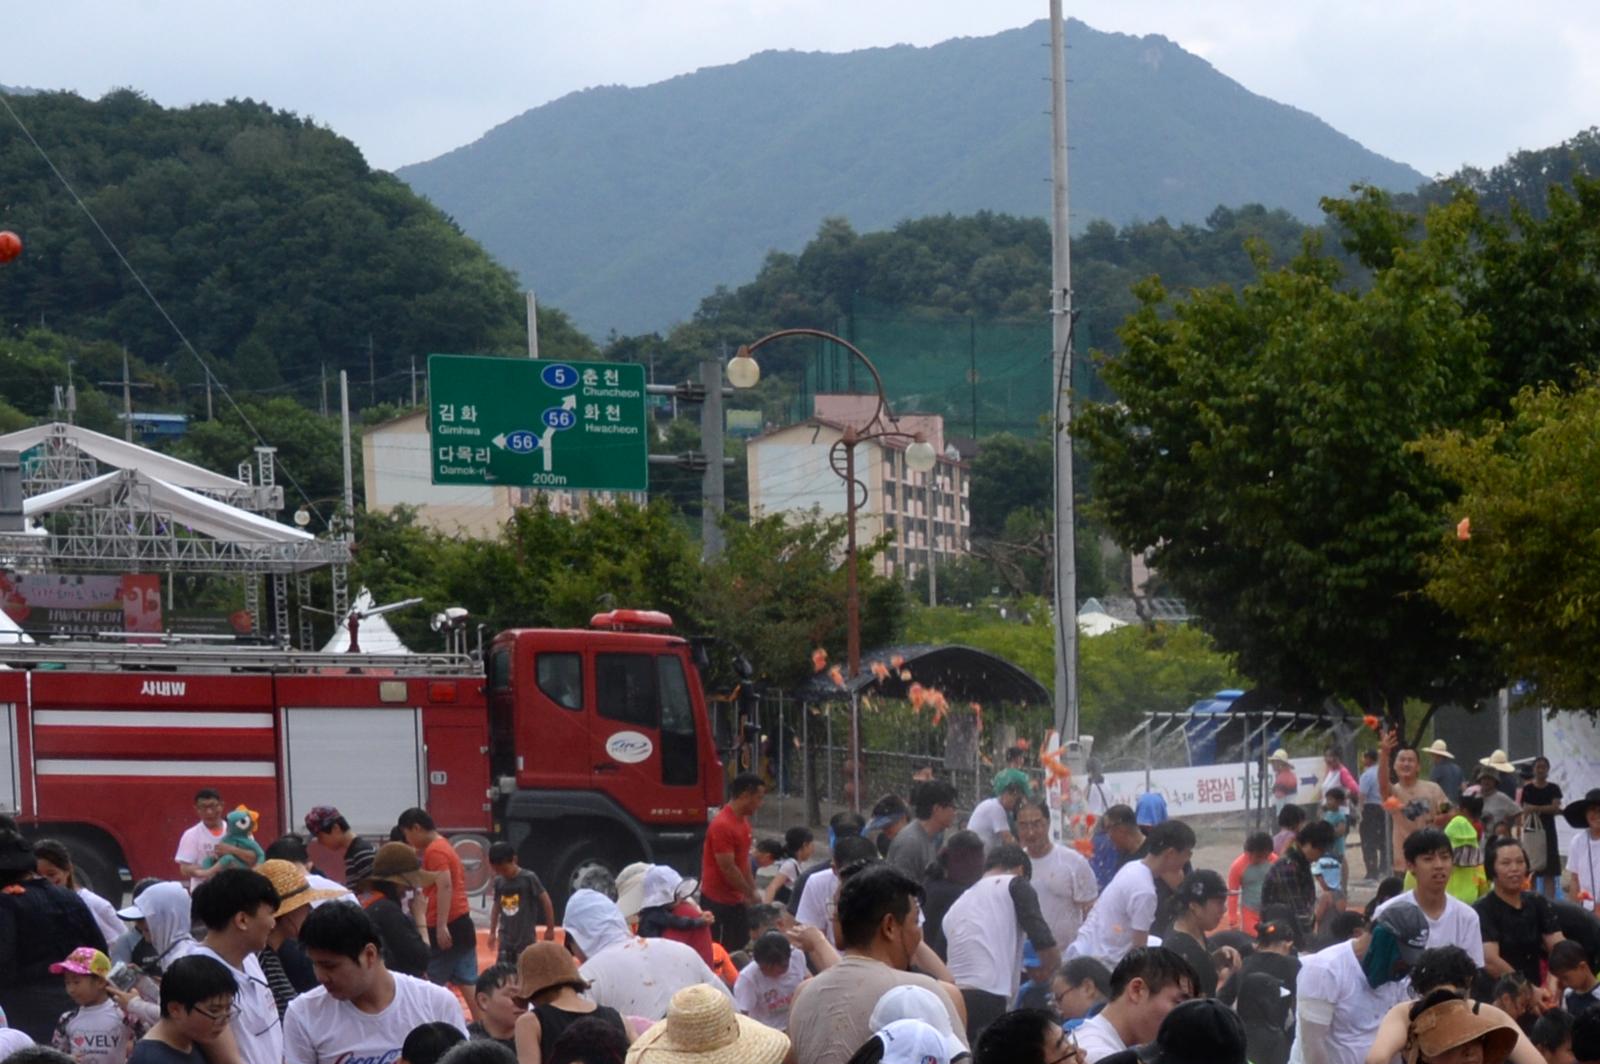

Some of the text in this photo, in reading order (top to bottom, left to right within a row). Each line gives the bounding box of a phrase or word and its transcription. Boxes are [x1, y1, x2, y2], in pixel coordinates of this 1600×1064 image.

[554, 368, 566, 384] 5
[582, 369, 619, 386] 춘천
[582, 387, 640, 398] Chuncheon
[438, 404, 477, 423] 김화
[549, 412, 570, 426] 56
[584, 404, 622, 422] 화천
[438, 425, 481, 436] Gimhwa
[585, 424, 638, 435] Hwacheon
[512, 435, 533, 449] 56
[439, 446, 491, 464] 다목리
[532, 473, 567, 485] 200m
[48, 609, 122, 622] HWACHEON
[1197, 776, 1236, 804] 화장실
